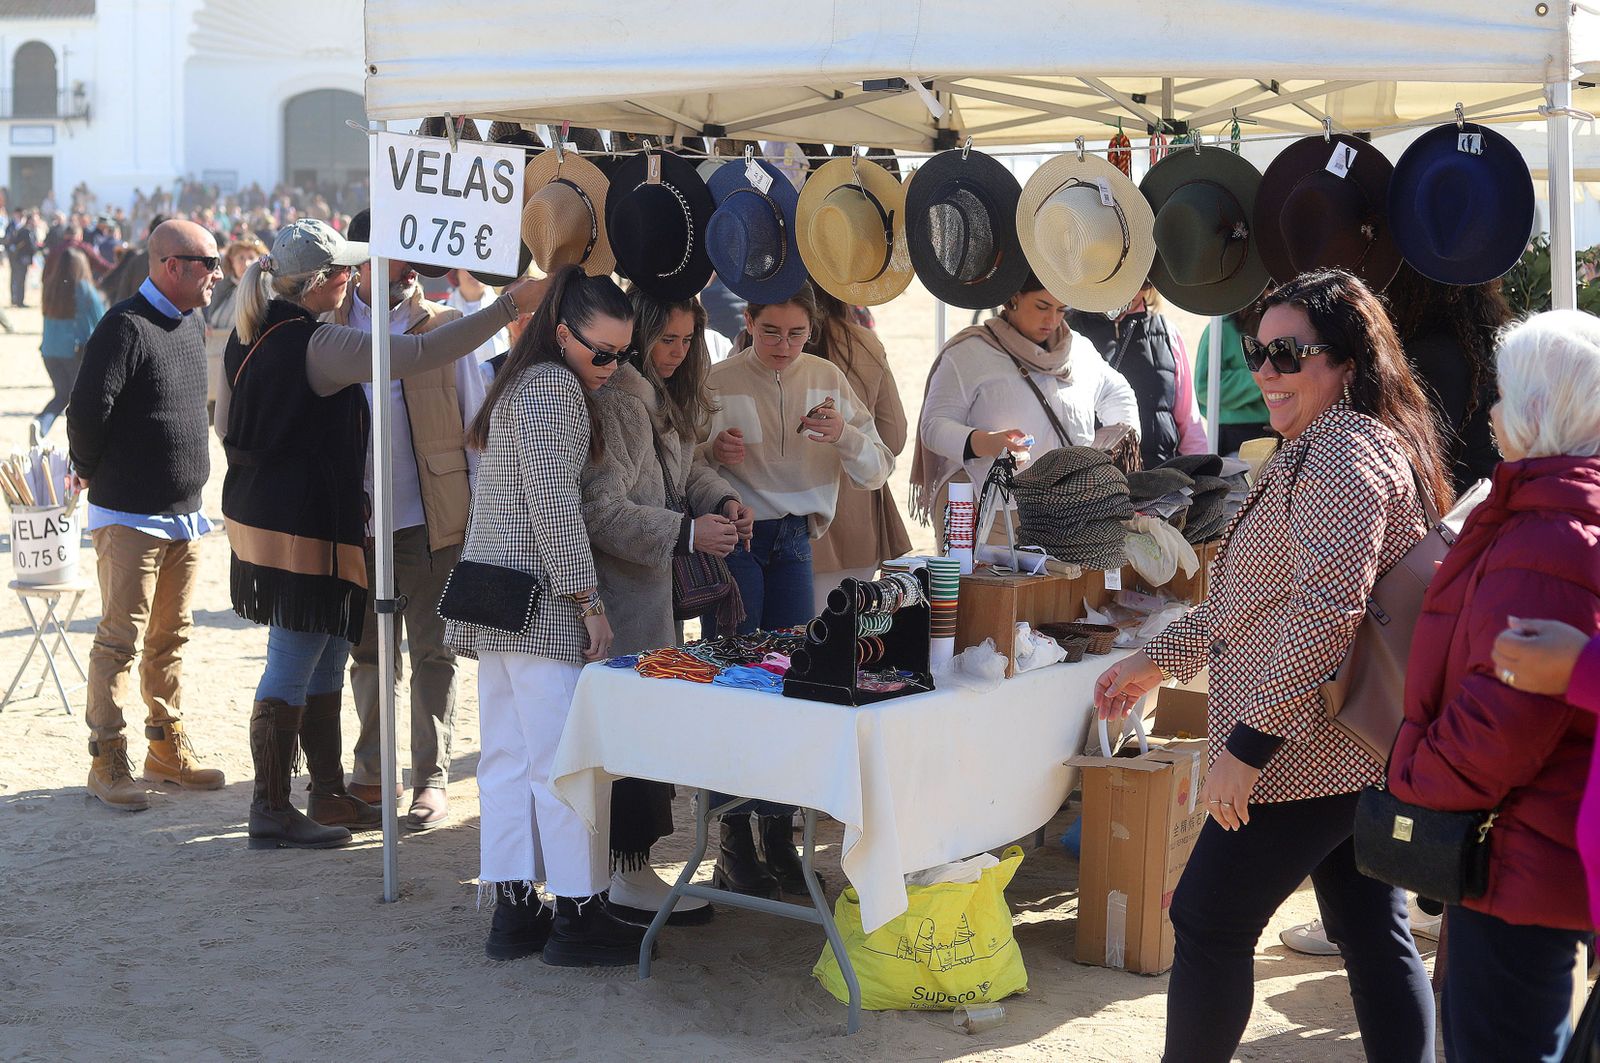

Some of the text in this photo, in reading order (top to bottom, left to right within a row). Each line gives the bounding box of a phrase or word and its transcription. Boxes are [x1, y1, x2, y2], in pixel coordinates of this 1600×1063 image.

[388, 146, 514, 204] VELAS
[400, 214, 493, 260] 0.75 €
[19, 545, 66, 568] 0.75 €
[912, 986, 976, 1004] Supeco
